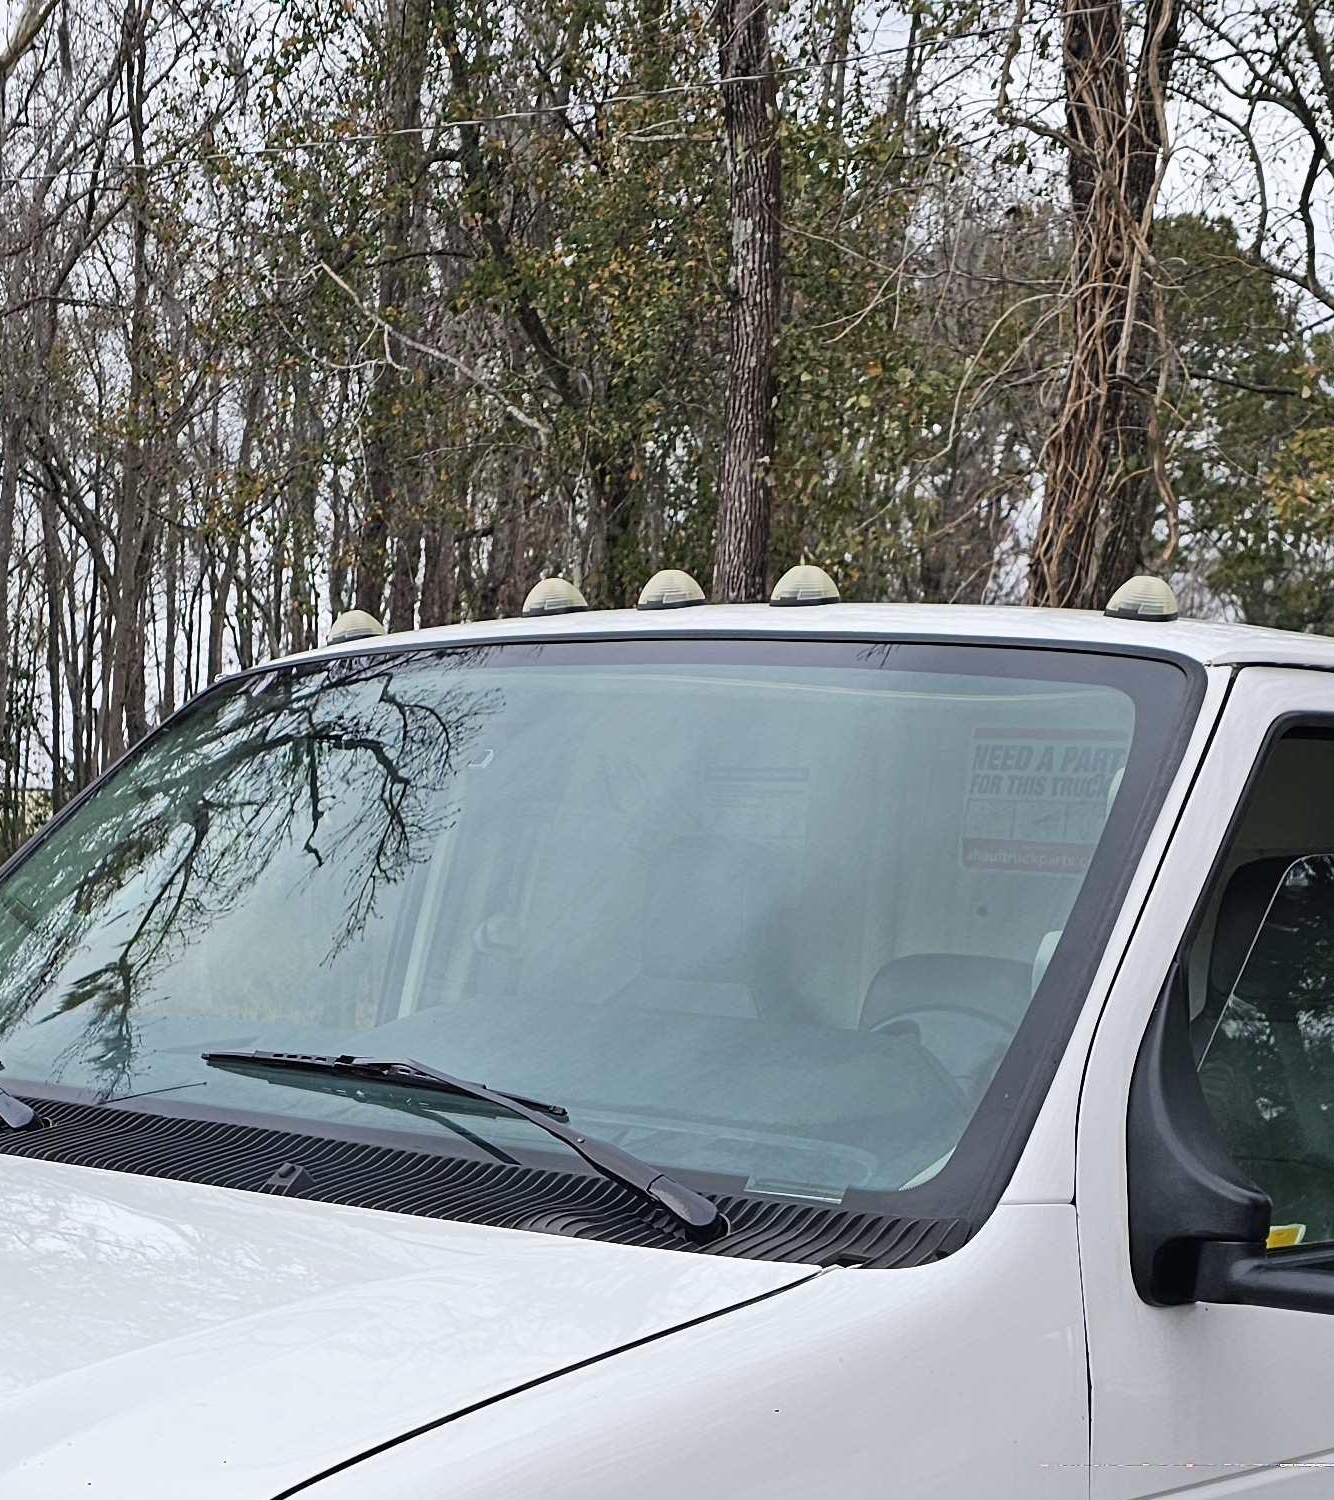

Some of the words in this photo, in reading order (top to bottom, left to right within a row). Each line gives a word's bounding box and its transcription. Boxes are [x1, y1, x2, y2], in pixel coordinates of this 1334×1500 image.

[971, 744, 1034, 771] NEED
[1035, 745, 1055, 772] A
[1059, 745, 1126, 773] PART
[969, 774, 1004, 795] FOR
[1006, 774, 1047, 796] THIS
[1051, 774, 1113, 798] TRUCK
[966, 847, 1091, 868] uhaultruckparts.c
